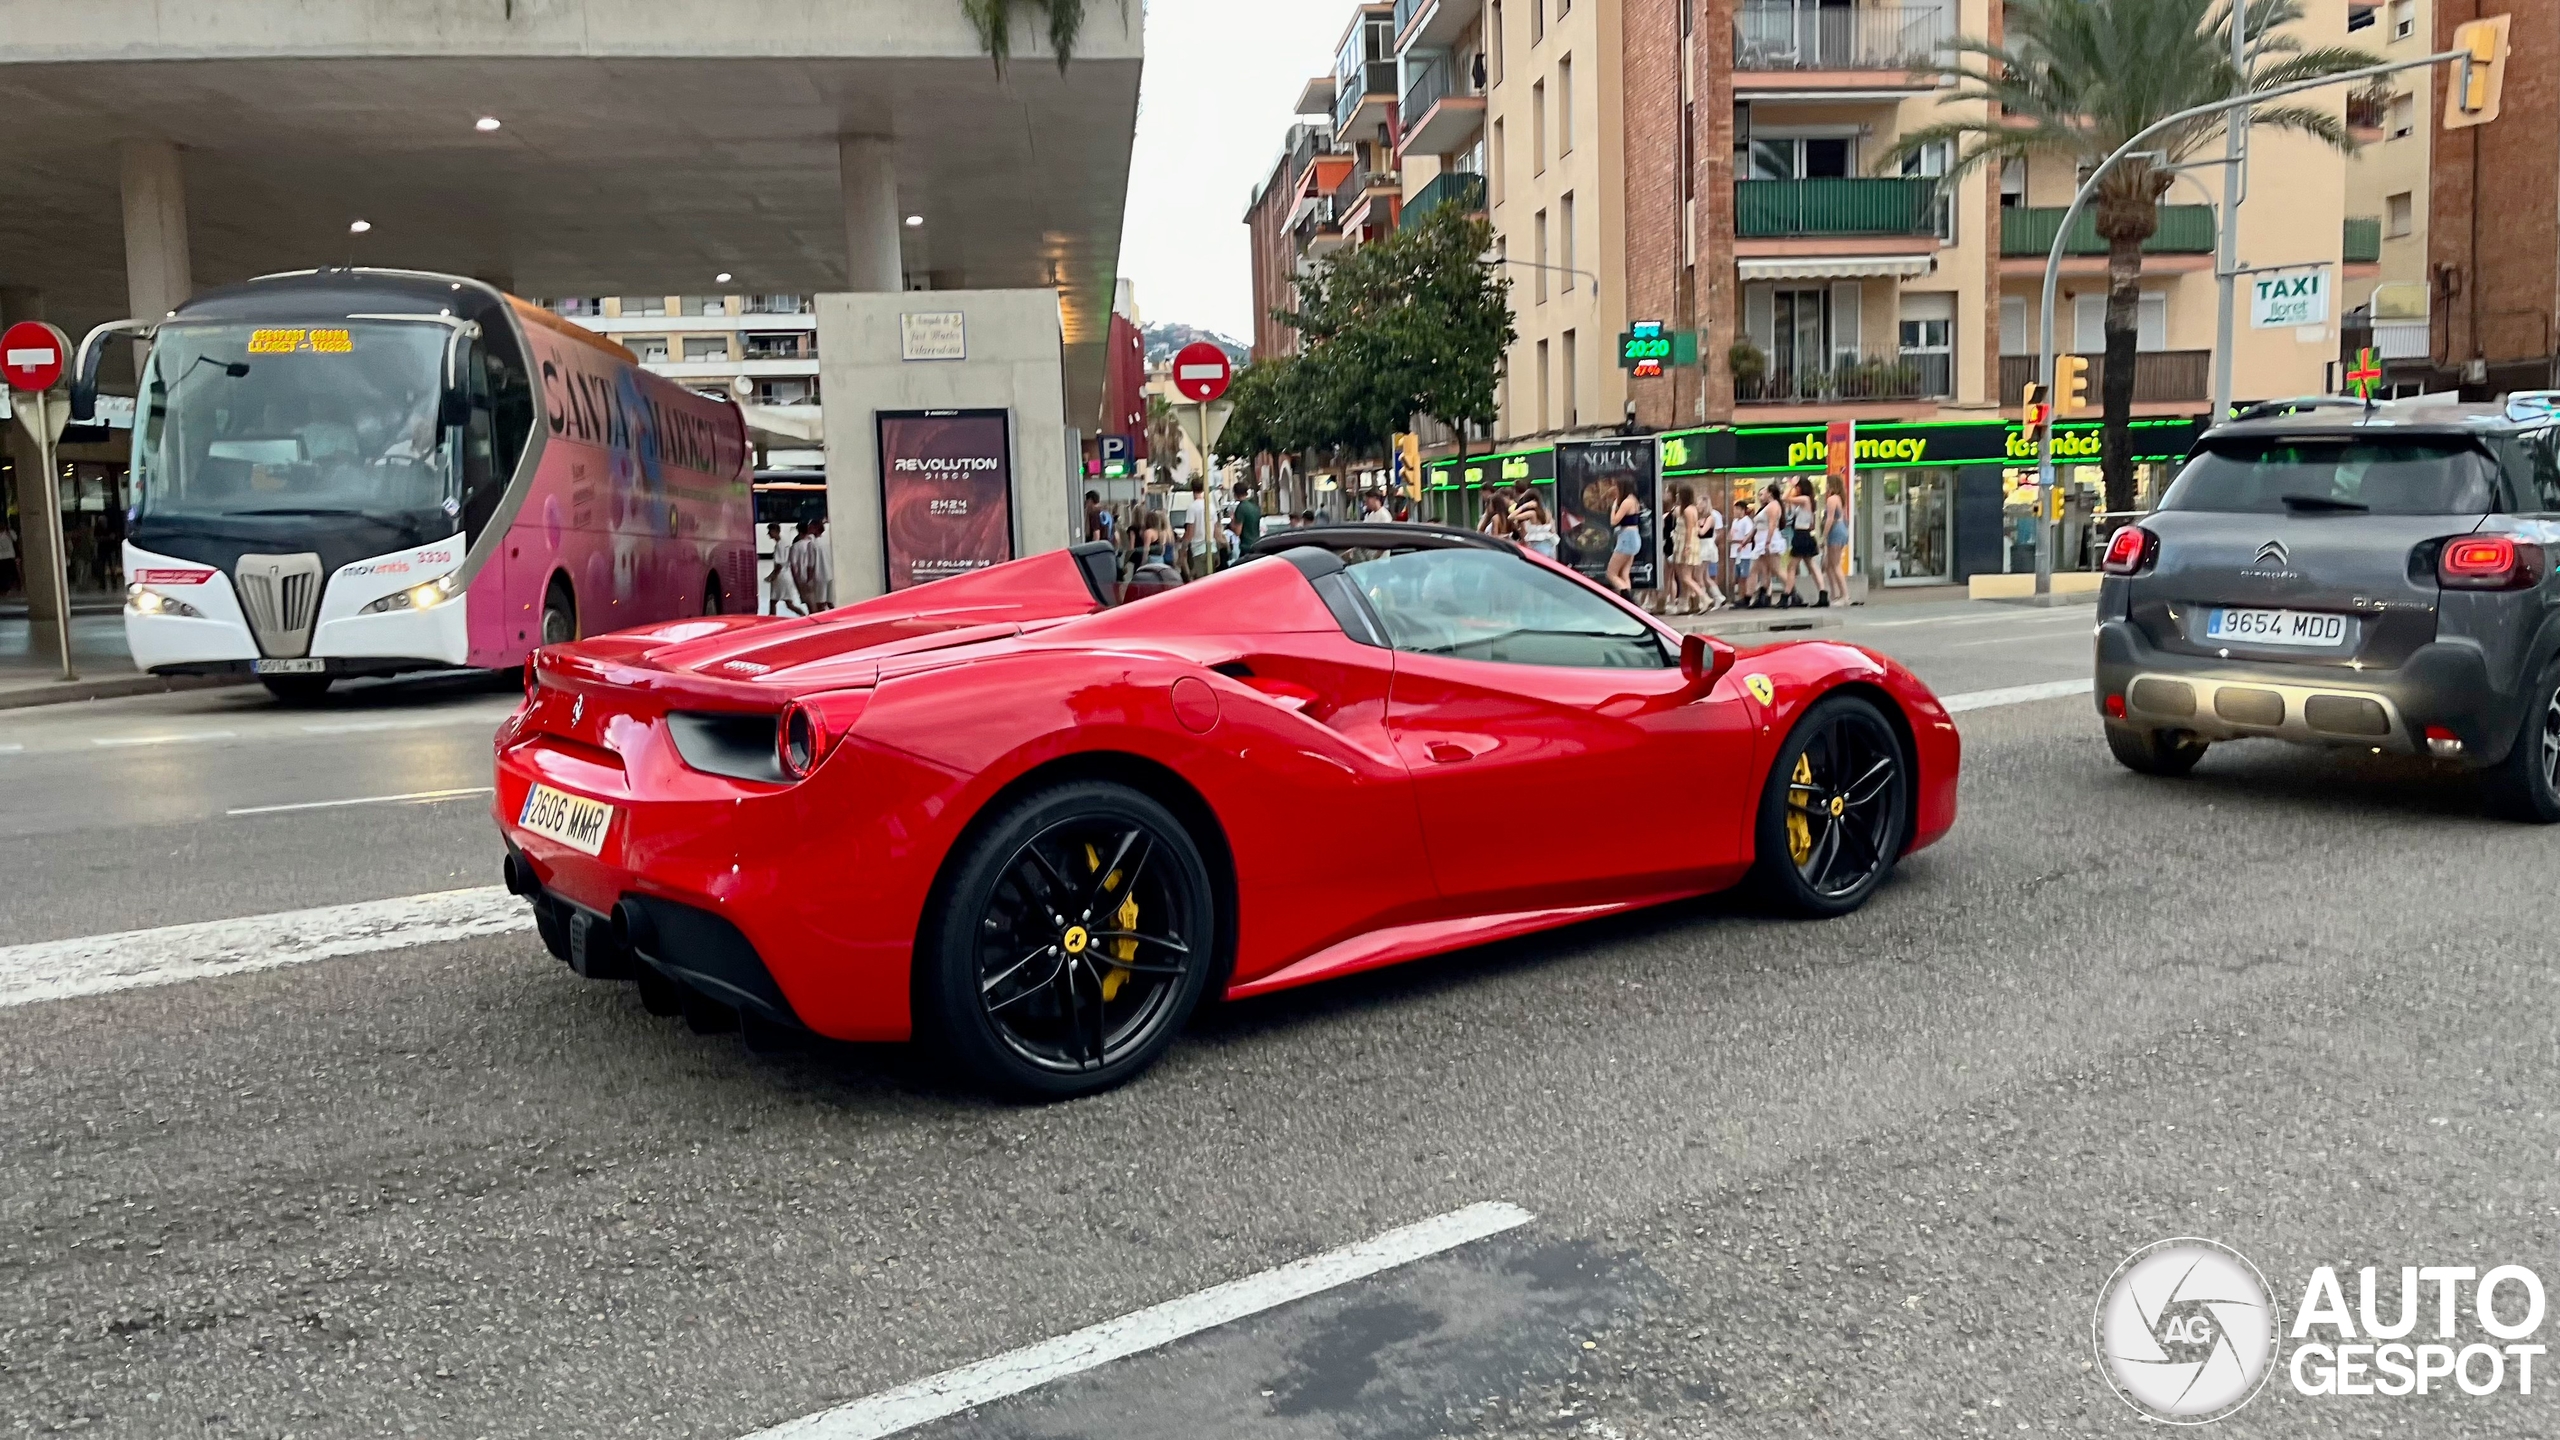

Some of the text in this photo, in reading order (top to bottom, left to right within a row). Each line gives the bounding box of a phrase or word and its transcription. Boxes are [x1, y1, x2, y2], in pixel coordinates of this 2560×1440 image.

[2257, 276, 2319, 300] TAXI
[2271, 300, 2308, 317] lloret
[1625, 339, 1670, 358] 20:20
[543, 360, 629, 449] SANTA
[1103, 438, 1124, 459] P
[1788, 433, 1926, 467] phmacy
[895, 457, 998, 471] REVOLUTION
[925, 472, 970, 480] DISCO
[417, 551, 451, 564] 3330
[936, 559, 990, 568] FOLLOW US
[2225, 612, 2341, 640] 9654 MDD
[529, 788, 605, 846] 2606 MMR
